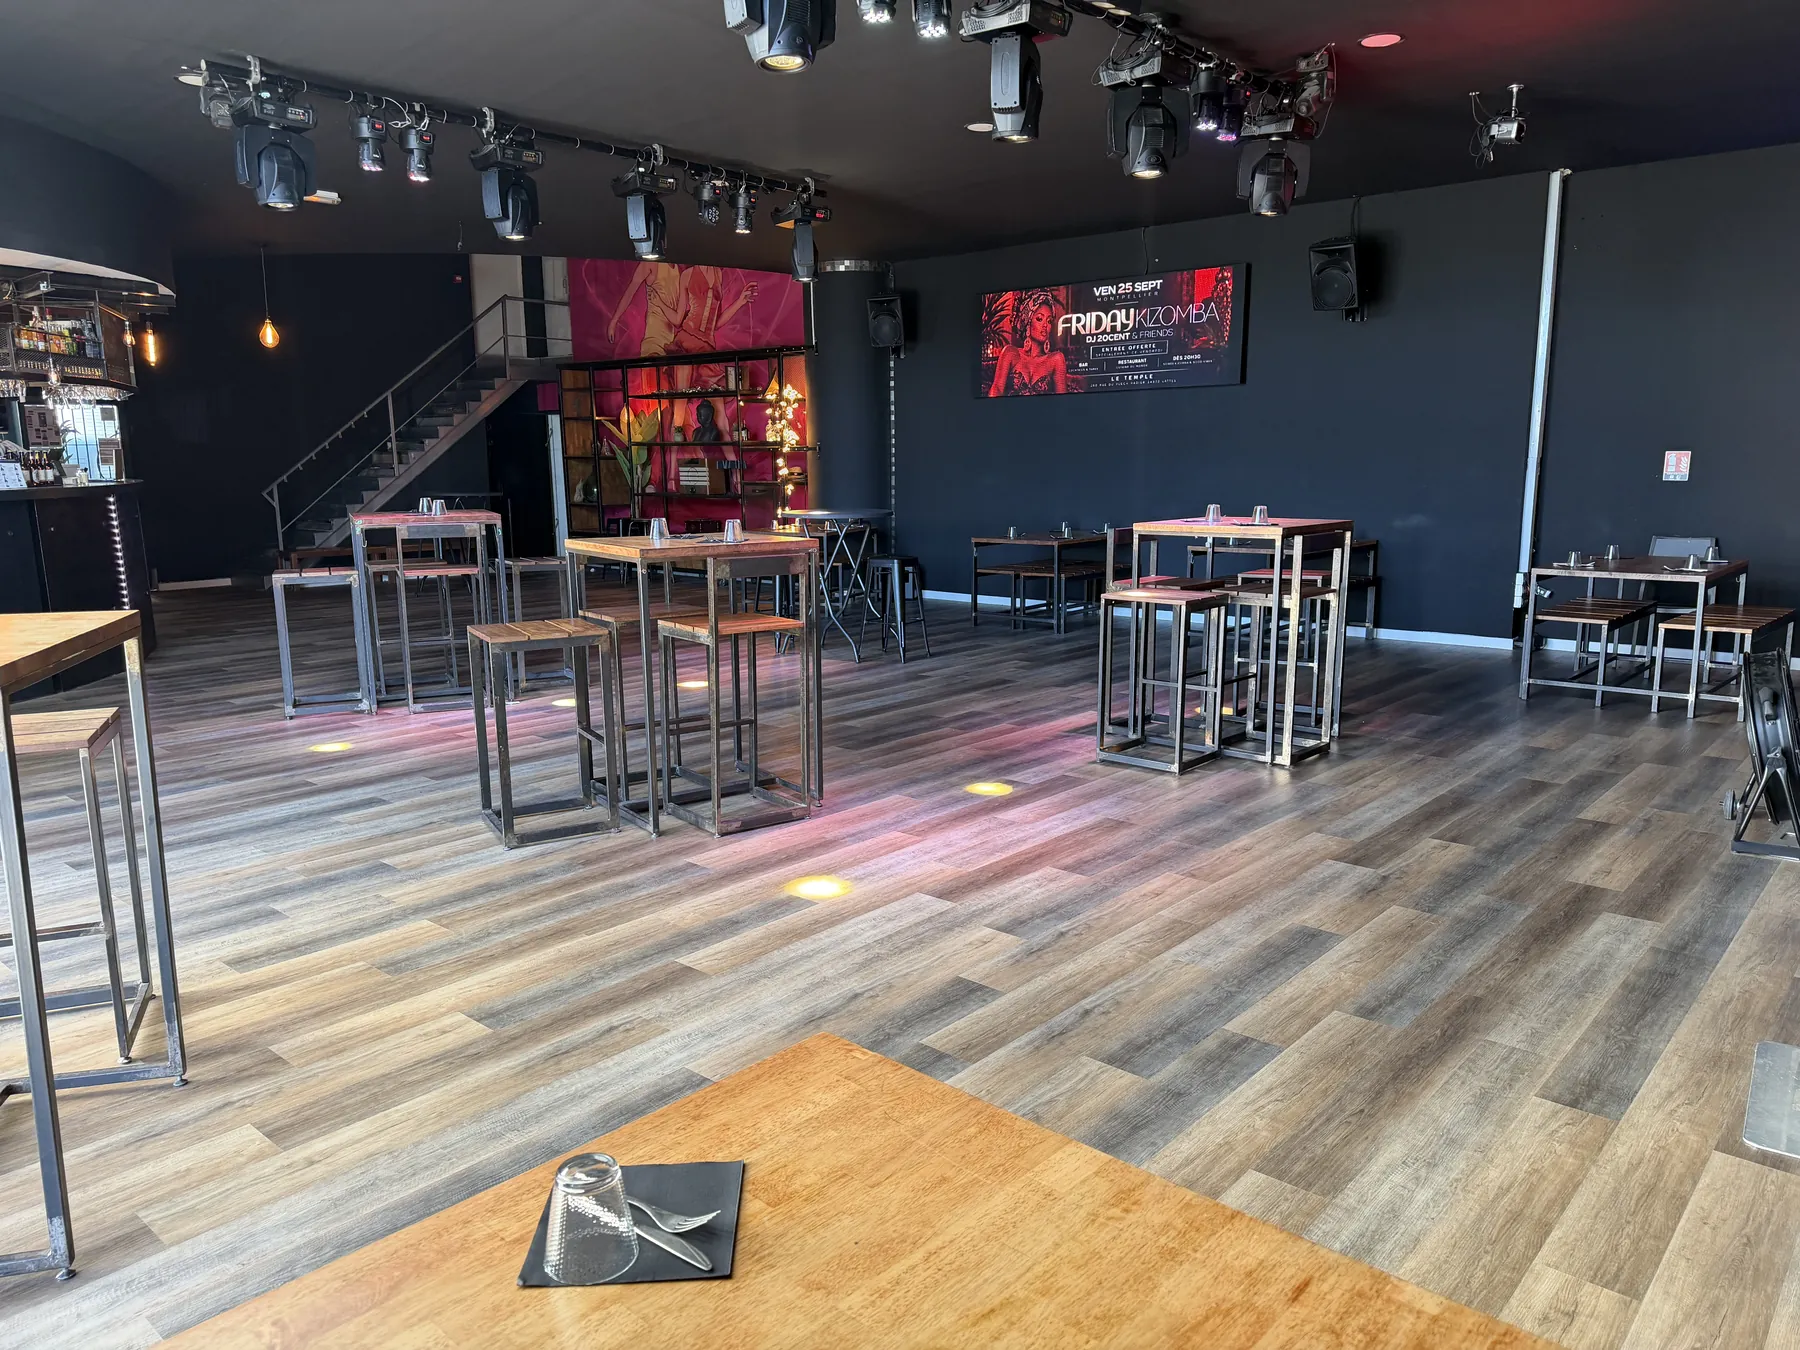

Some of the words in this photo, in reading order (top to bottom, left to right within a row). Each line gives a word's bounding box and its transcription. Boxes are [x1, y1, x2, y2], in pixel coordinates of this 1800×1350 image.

[1093, 286, 1117, 297] VEN
[1118, 282, 1132, 294] 25
[1134, 279, 1163, 292] SEPT
[1096, 291, 1159, 302] MONTPELLIER
[1057, 307, 1134, 337] FRIDAY
[1135, 301, 1220, 329] KIZOMBA
[1086, 335, 1097, 344] DJ
[1132, 331, 1138, 340] &
[1139, 328, 1174, 338] FRIENDS
[1124, 373, 1153, 381] TEMPLE
